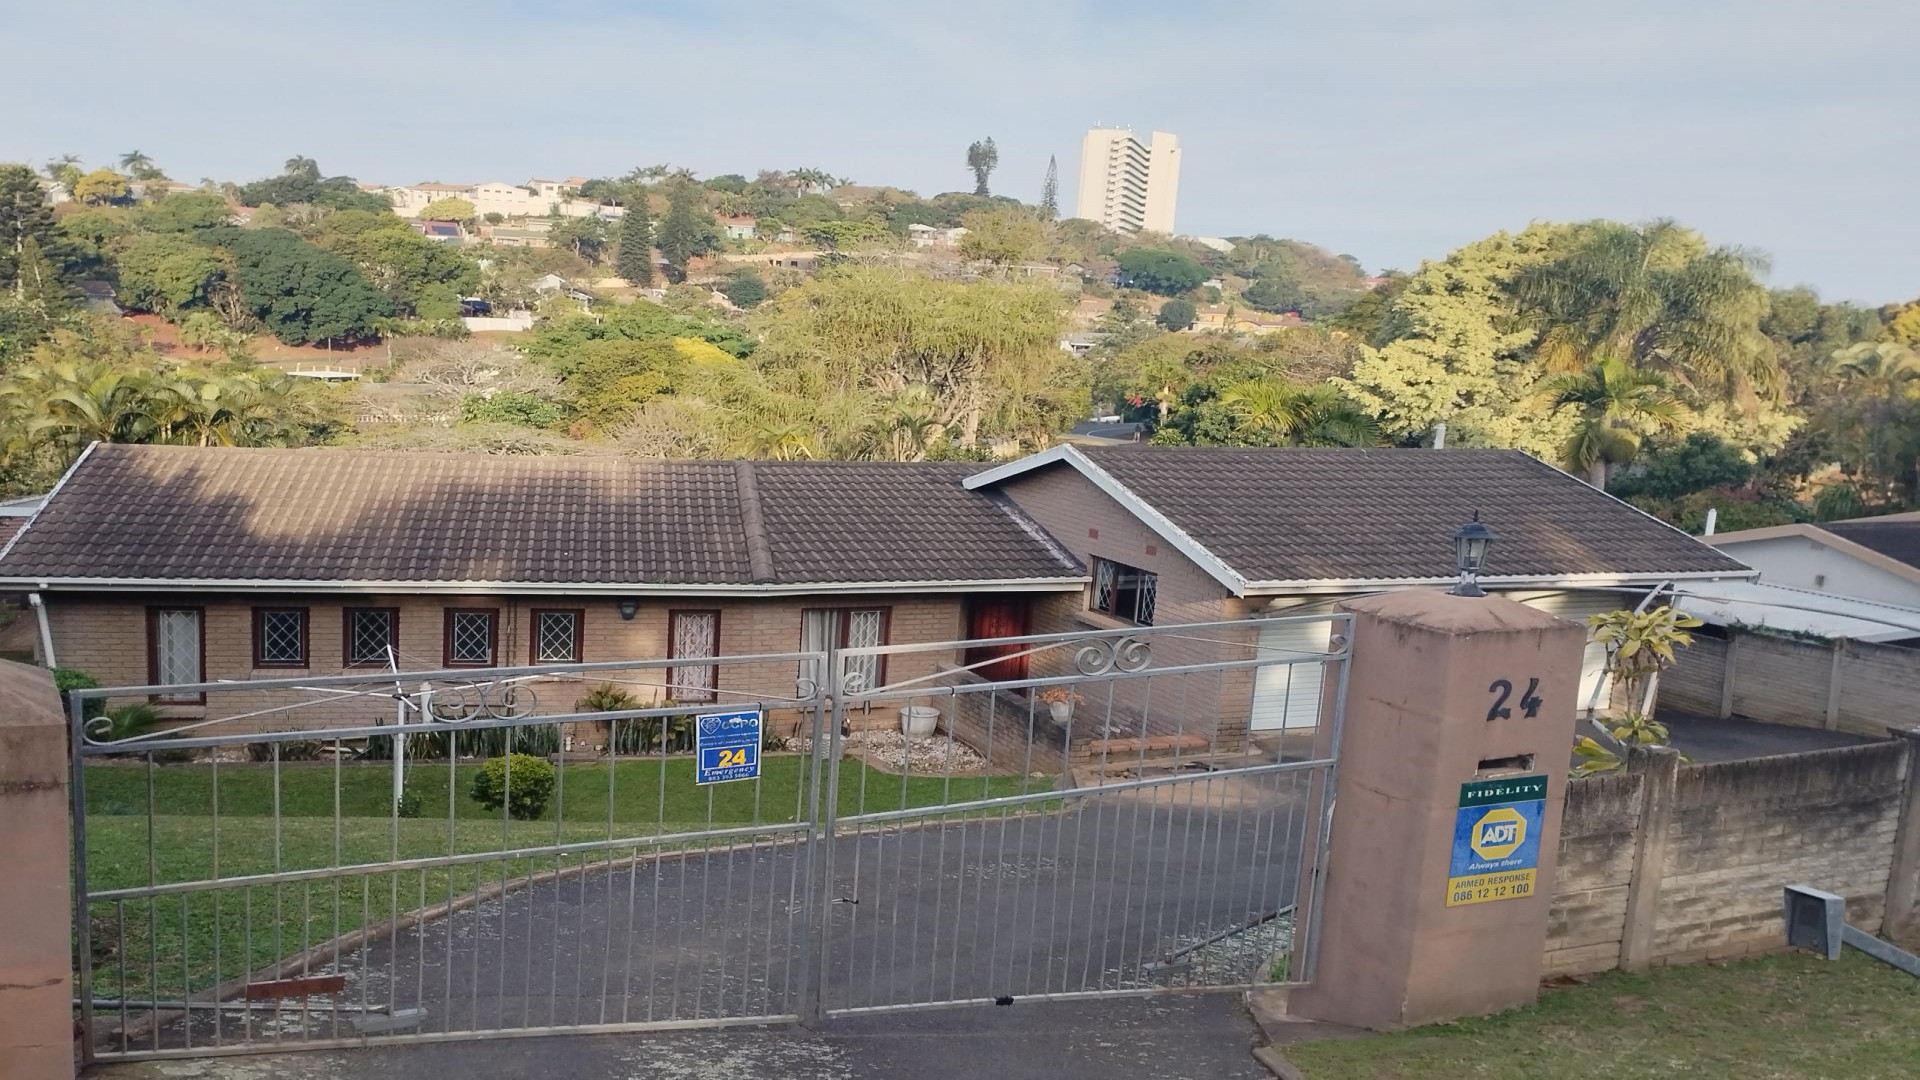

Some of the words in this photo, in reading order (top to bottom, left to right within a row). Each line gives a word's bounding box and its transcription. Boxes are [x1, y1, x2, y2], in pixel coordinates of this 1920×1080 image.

[1486, 677, 1543, 722] 24
[718, 748, 746, 768] 24
[704, 766, 755, 777] Emergency
[1467, 784, 1543, 799] FIDELITY
[1481, 824, 1518, 845] ADT
[1469, 860, 1499, 870] Always
[1500, 858, 1523, 867] there
[1455, 878, 1485, 889] ARMED
[1487, 872, 1531, 885] RESPONSE
[1453, 890, 1473, 902] 086
[1477, 888, 1489, 898] 12
[1494, 886, 1506, 896] 12
[1511, 883, 1529, 894] 100
